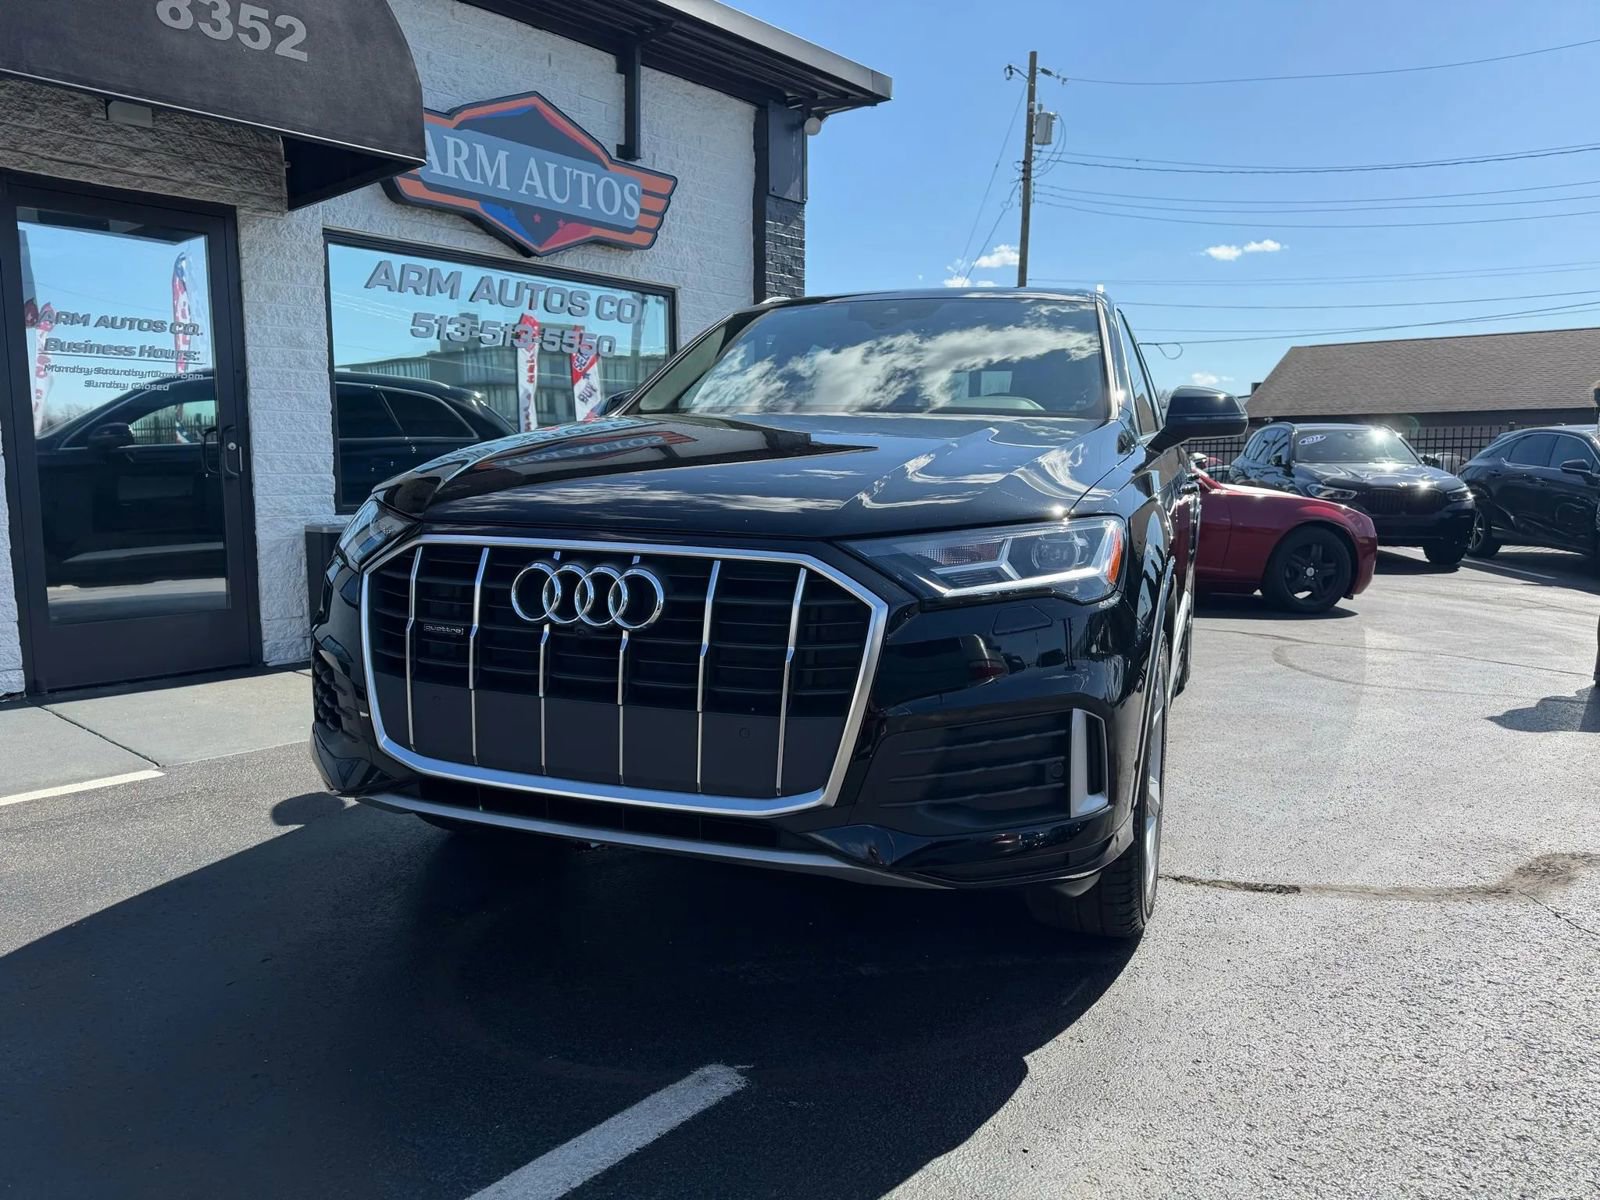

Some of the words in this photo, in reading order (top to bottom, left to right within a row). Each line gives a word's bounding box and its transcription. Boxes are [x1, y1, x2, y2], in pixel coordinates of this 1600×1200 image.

[155, 0, 308, 63] 8352
[425, 129, 511, 191] ARM
[518, 156, 640, 221] AUTOS
[364, 259, 462, 300] ARM
[469, 275, 590, 318] AUTOS
[595, 294, 642, 325] CO
[38, 310, 91, 328] ARM
[94, 314, 168, 334] AUTOS
[410, 311, 617, 359] 513-513-5550
[43, 337, 137, 358] Business
[138, 345, 201, 362] Hours:
[84, 379, 129, 392] Sunday
[131, 381, 170, 392] Closed
